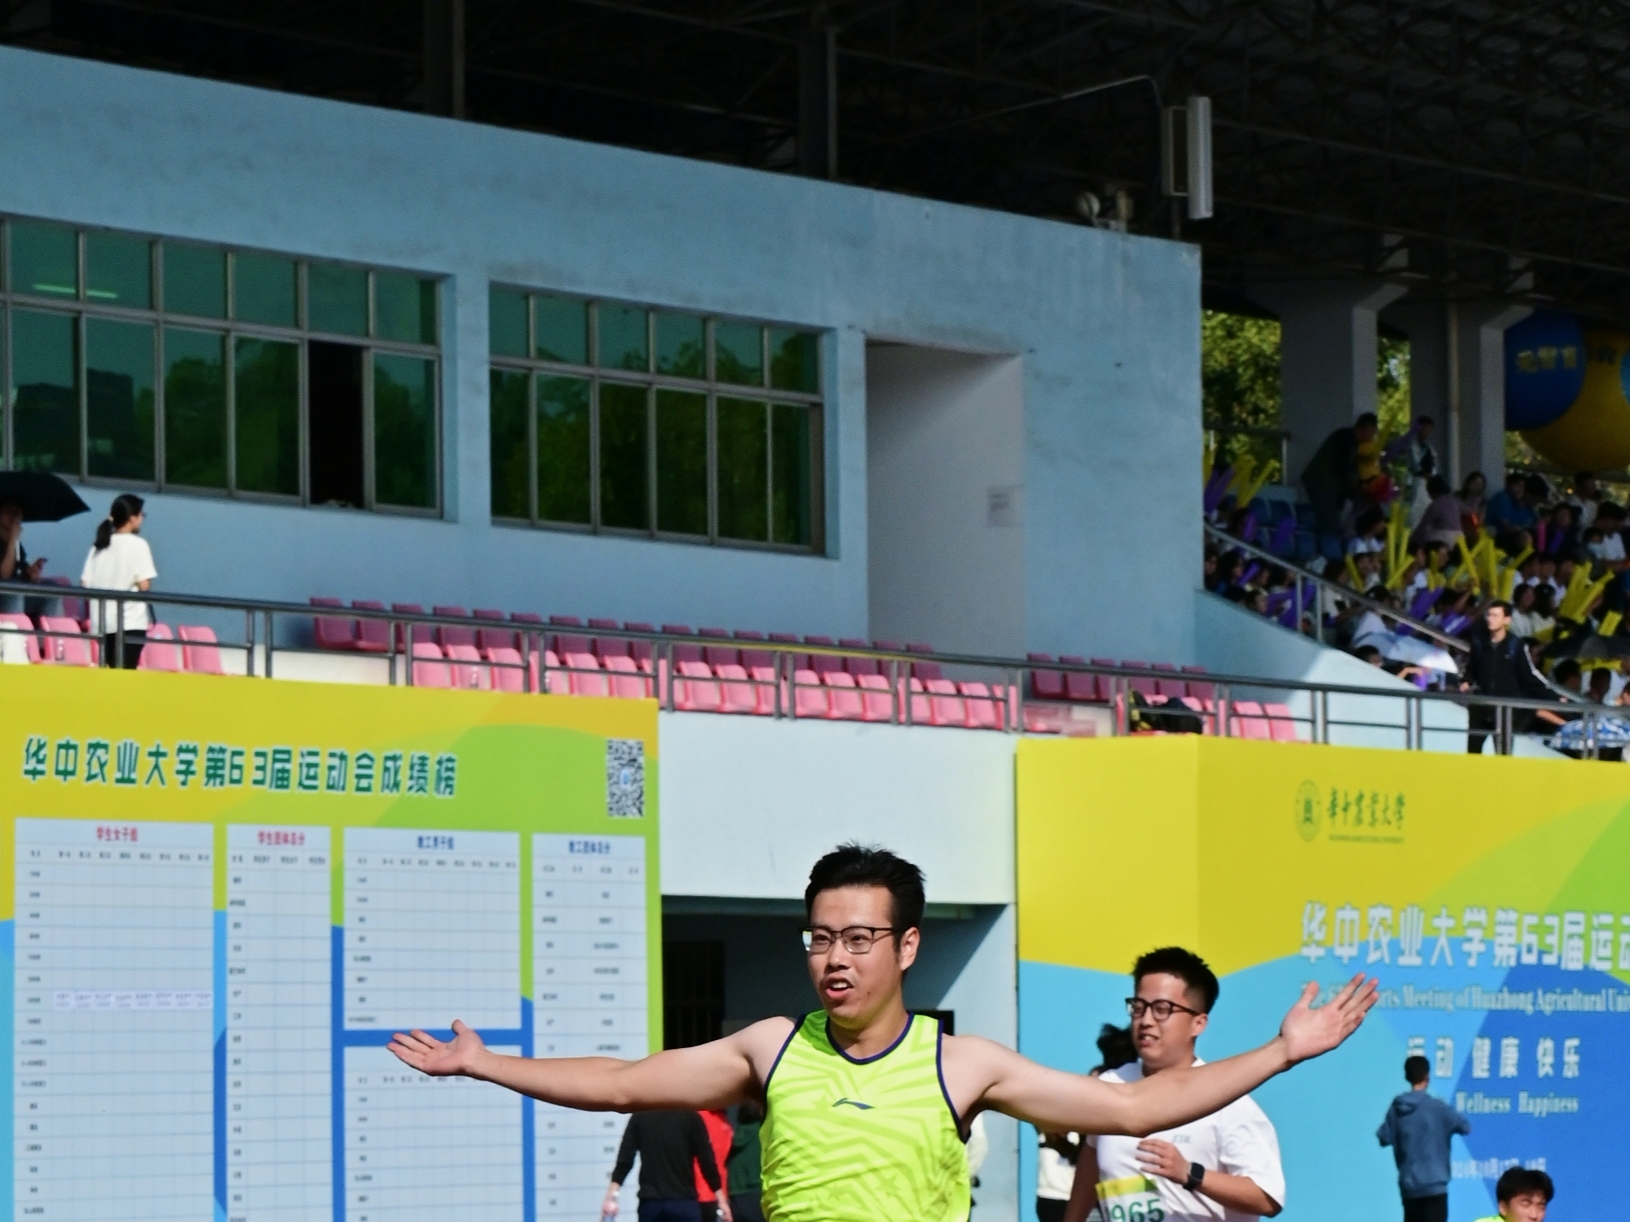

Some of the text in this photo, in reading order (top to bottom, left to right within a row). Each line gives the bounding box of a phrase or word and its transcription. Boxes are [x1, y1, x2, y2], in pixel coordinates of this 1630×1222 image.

[22, 736, 458, 798] 华中农业大学第63届运动会成绩榜
[1518, 1090, 1579, 1117] Happiness
